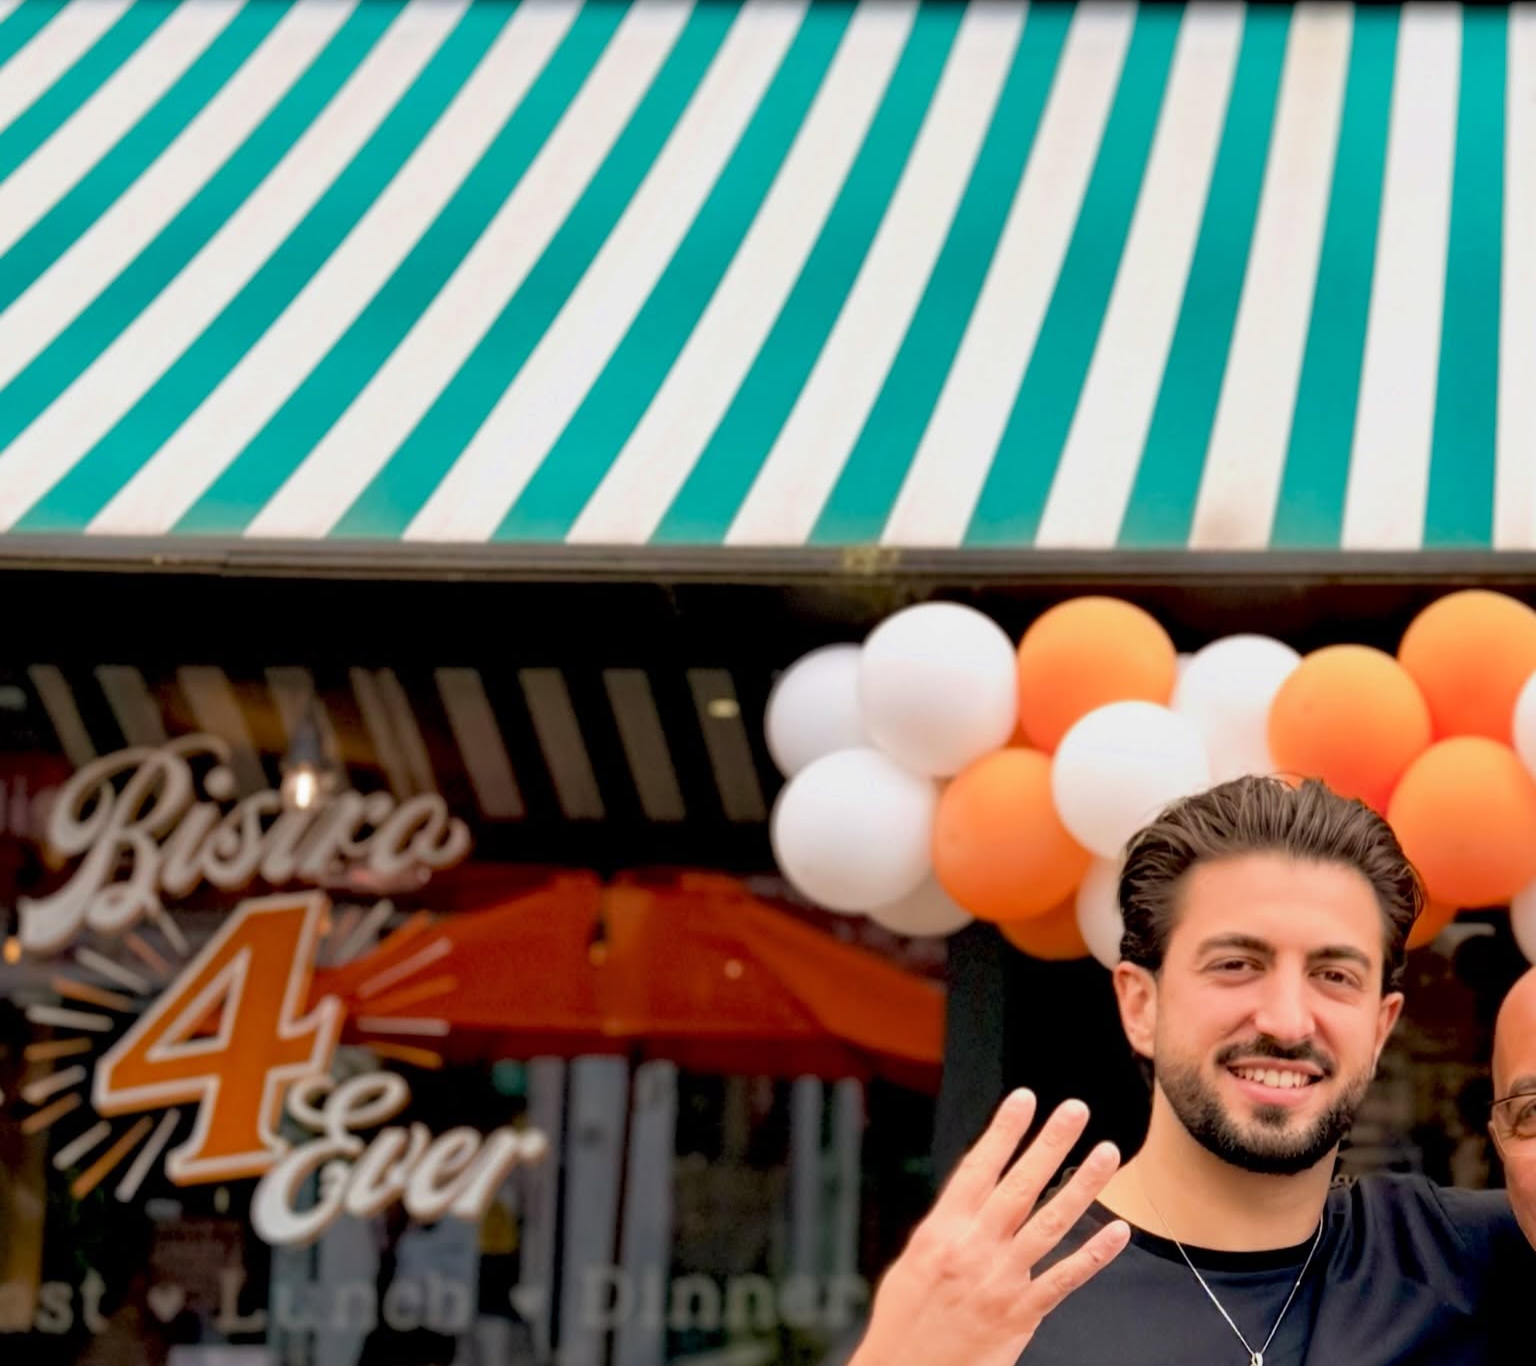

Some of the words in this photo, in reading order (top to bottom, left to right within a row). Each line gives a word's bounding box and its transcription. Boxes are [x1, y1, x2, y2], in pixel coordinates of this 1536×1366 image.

[17, 734, 473, 953] Bistro
[92, 889, 347, 1188] 4
[250, 1071, 549, 1247] Ever
